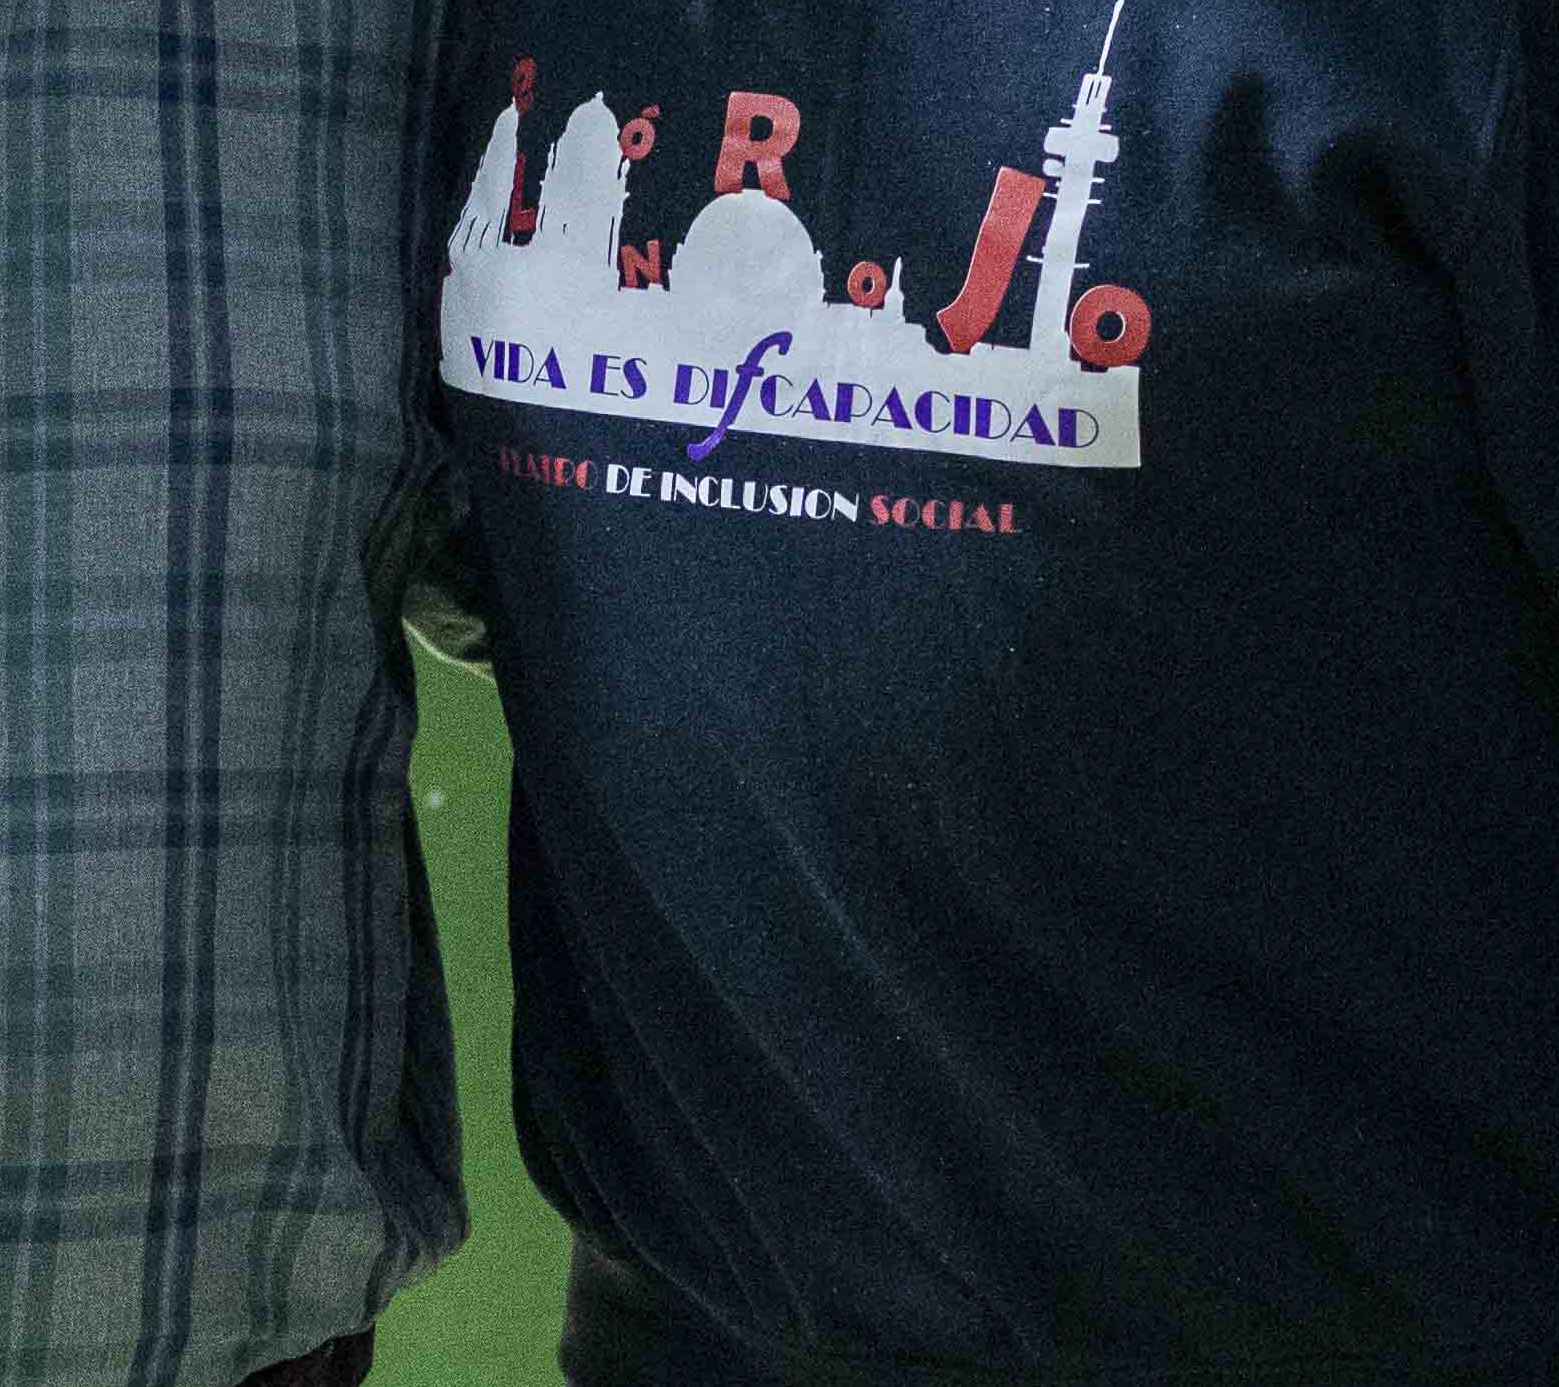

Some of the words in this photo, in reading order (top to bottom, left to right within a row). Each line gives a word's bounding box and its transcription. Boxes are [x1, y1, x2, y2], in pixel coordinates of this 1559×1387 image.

[468, 335, 567, 390] VIDA
[590, 353, 647, 399] ES
[606, 464, 652, 497] DE
[660, 471, 858, 522] INCLUSION
[869, 495, 1020, 534] SOCIAL
